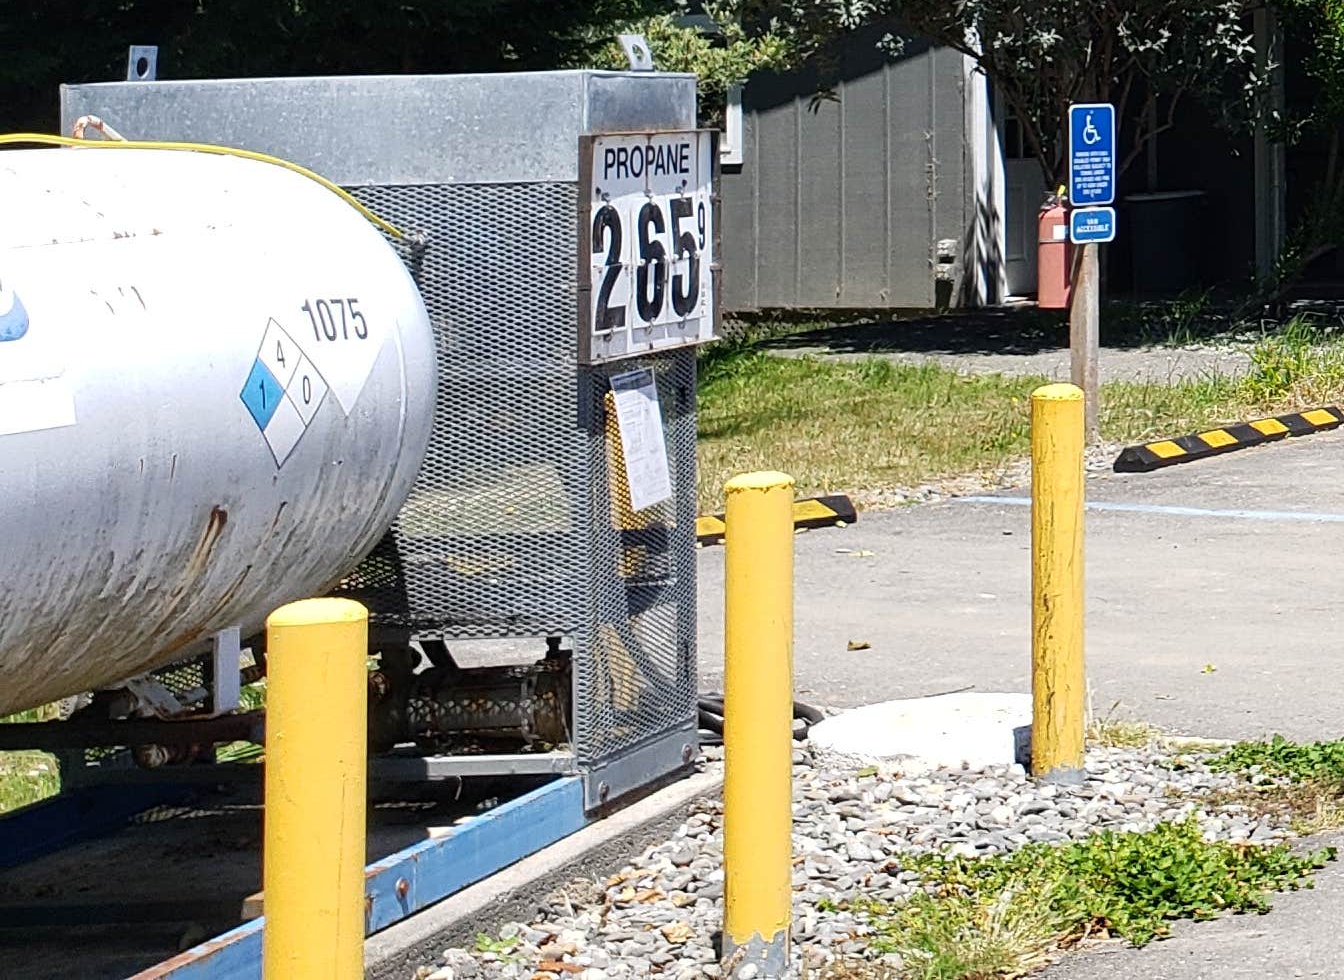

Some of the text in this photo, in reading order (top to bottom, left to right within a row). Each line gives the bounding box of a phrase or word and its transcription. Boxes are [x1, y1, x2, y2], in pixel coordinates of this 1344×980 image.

[604, 143, 690, 180] PROPANE
[301, 298, 368, 342] 1075
[276, 339, 286, 369] 4
[259, 379, 267, 411] 1
[302, 374, 311, 405] 0
